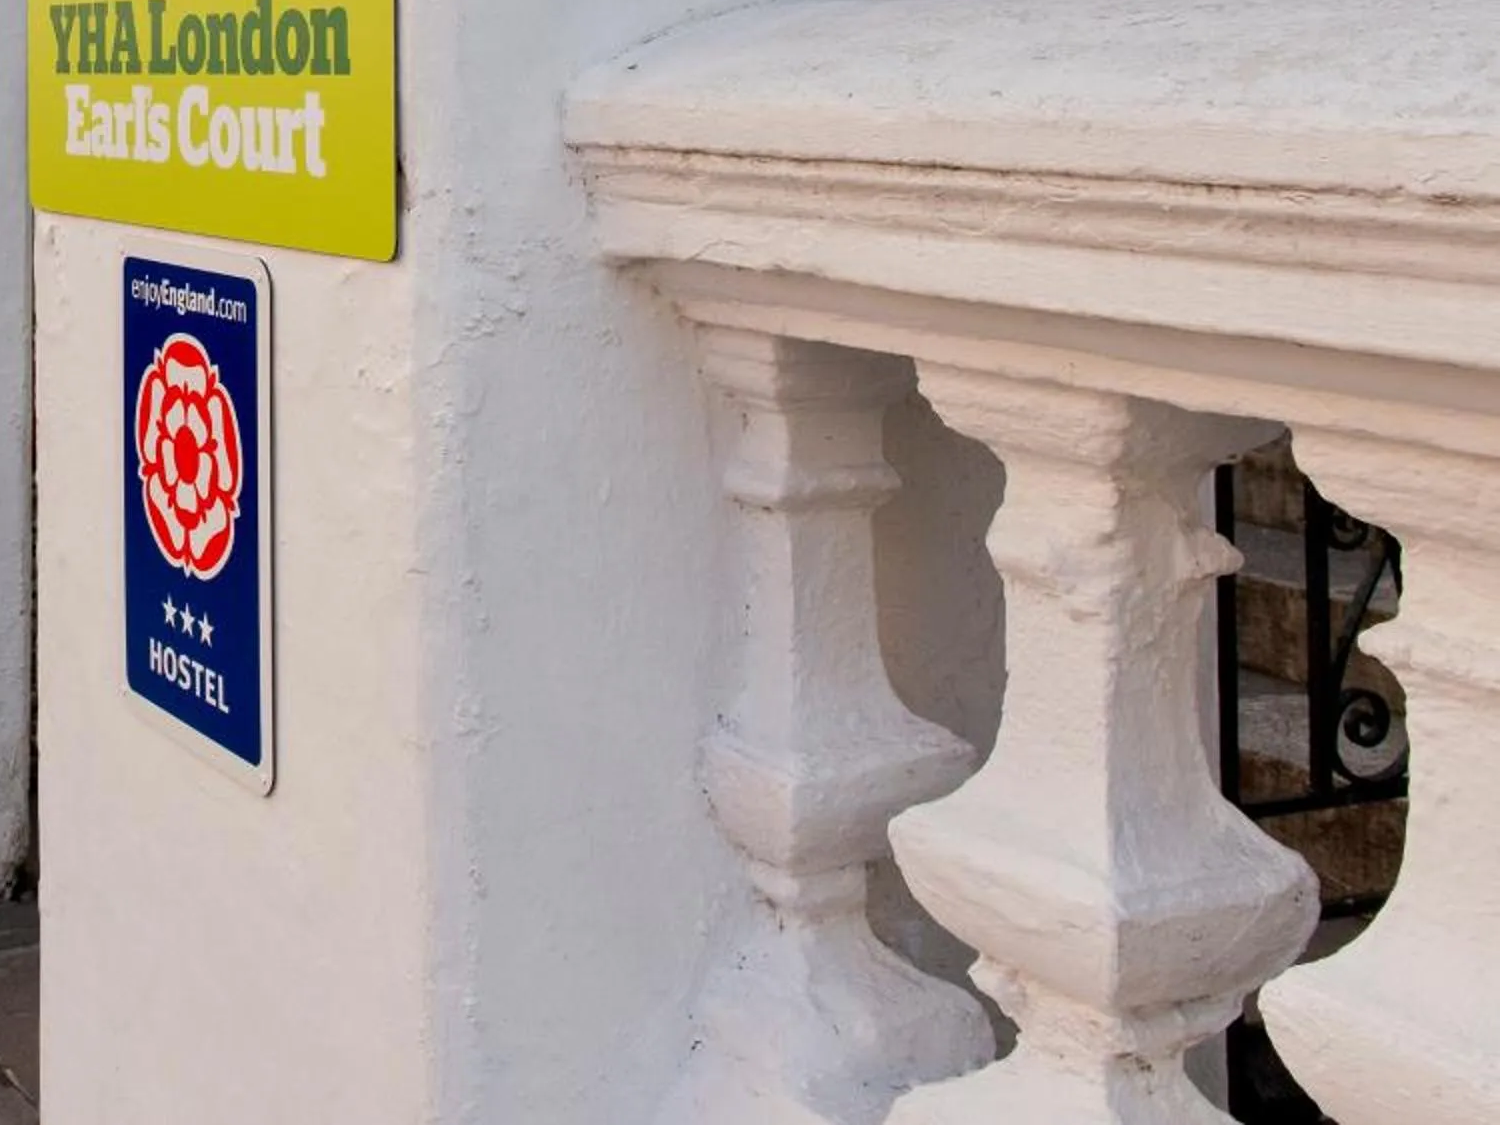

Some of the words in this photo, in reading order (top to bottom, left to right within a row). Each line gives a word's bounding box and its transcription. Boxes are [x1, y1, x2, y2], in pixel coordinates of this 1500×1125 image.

[49, 0, 143, 75] YHA
[177, 84, 326, 178] Court
[131, 275, 247, 323] enjoyEngland.com
[149, 637, 230, 714] HOSTEL
